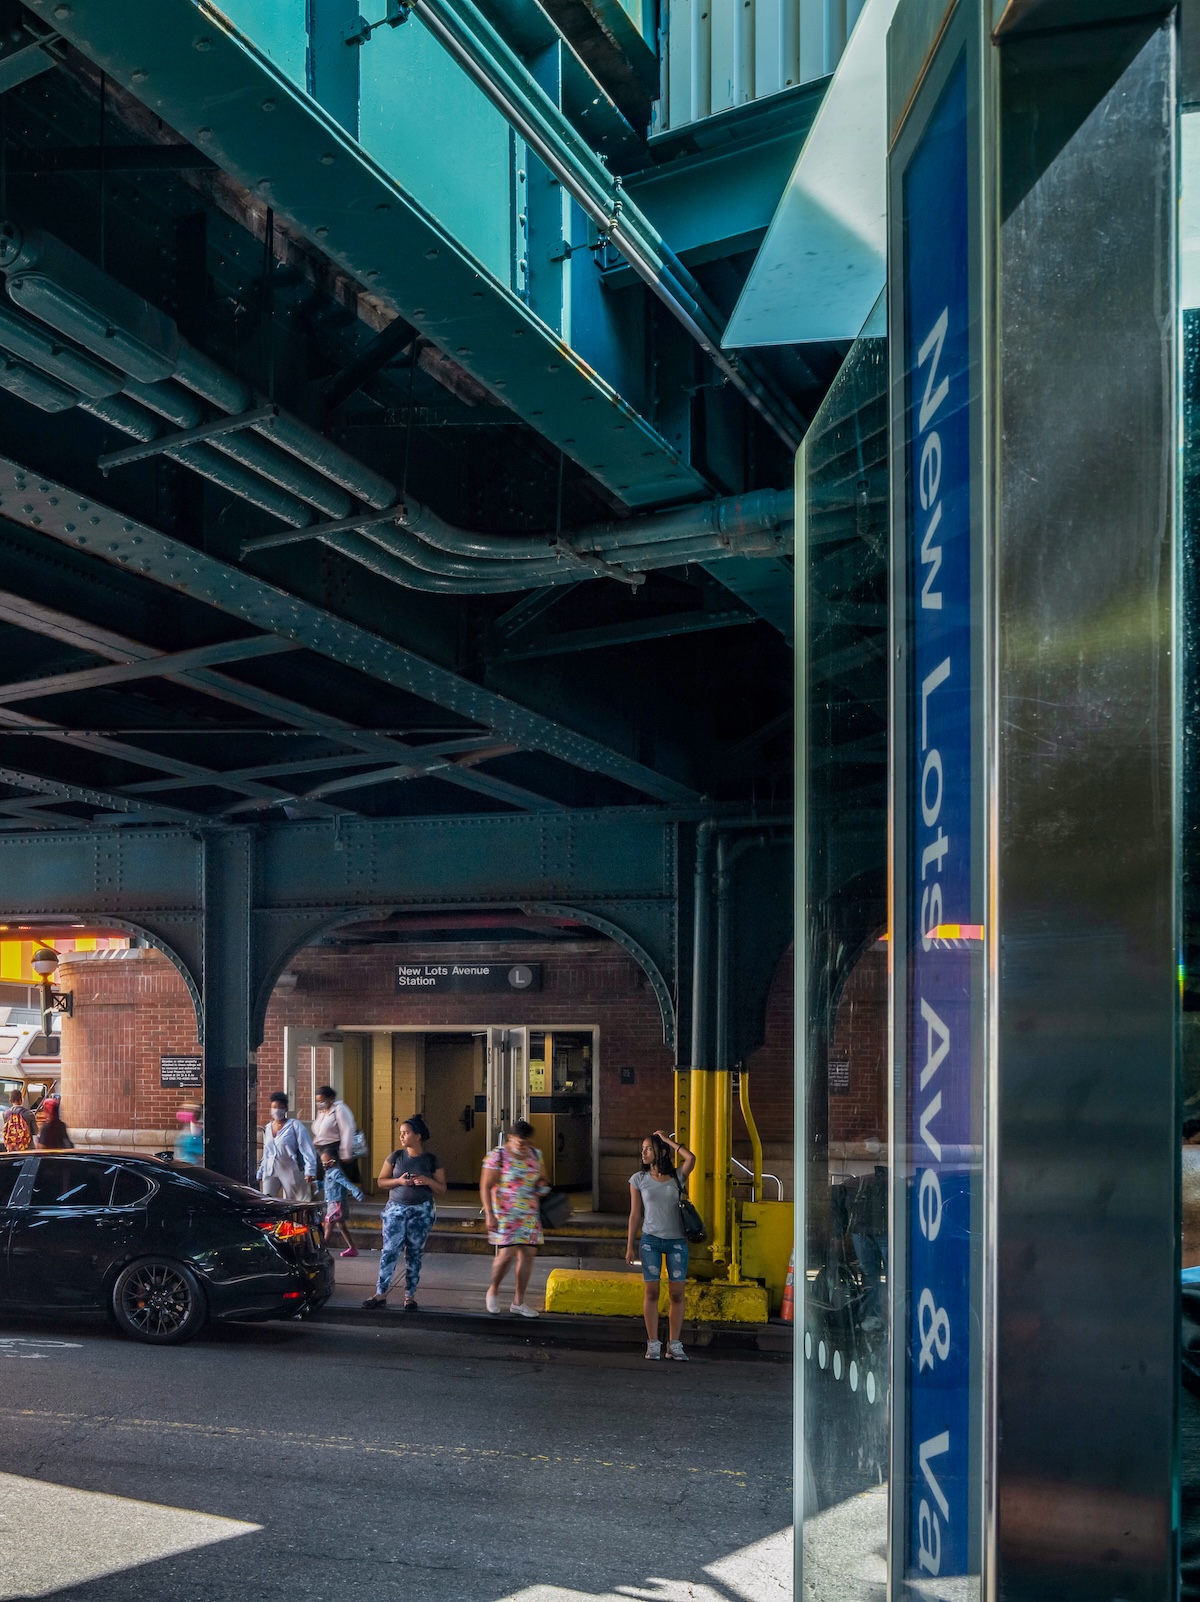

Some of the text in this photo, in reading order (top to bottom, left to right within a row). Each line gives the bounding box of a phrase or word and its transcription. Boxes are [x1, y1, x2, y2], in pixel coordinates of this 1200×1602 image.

[917, 305, 951, 1602] New Lots Ave & Va
[398, 966, 490, 976] New Lots Avenue
[515, 970, 526, 983] L
[398, 976, 436, 986] Station
